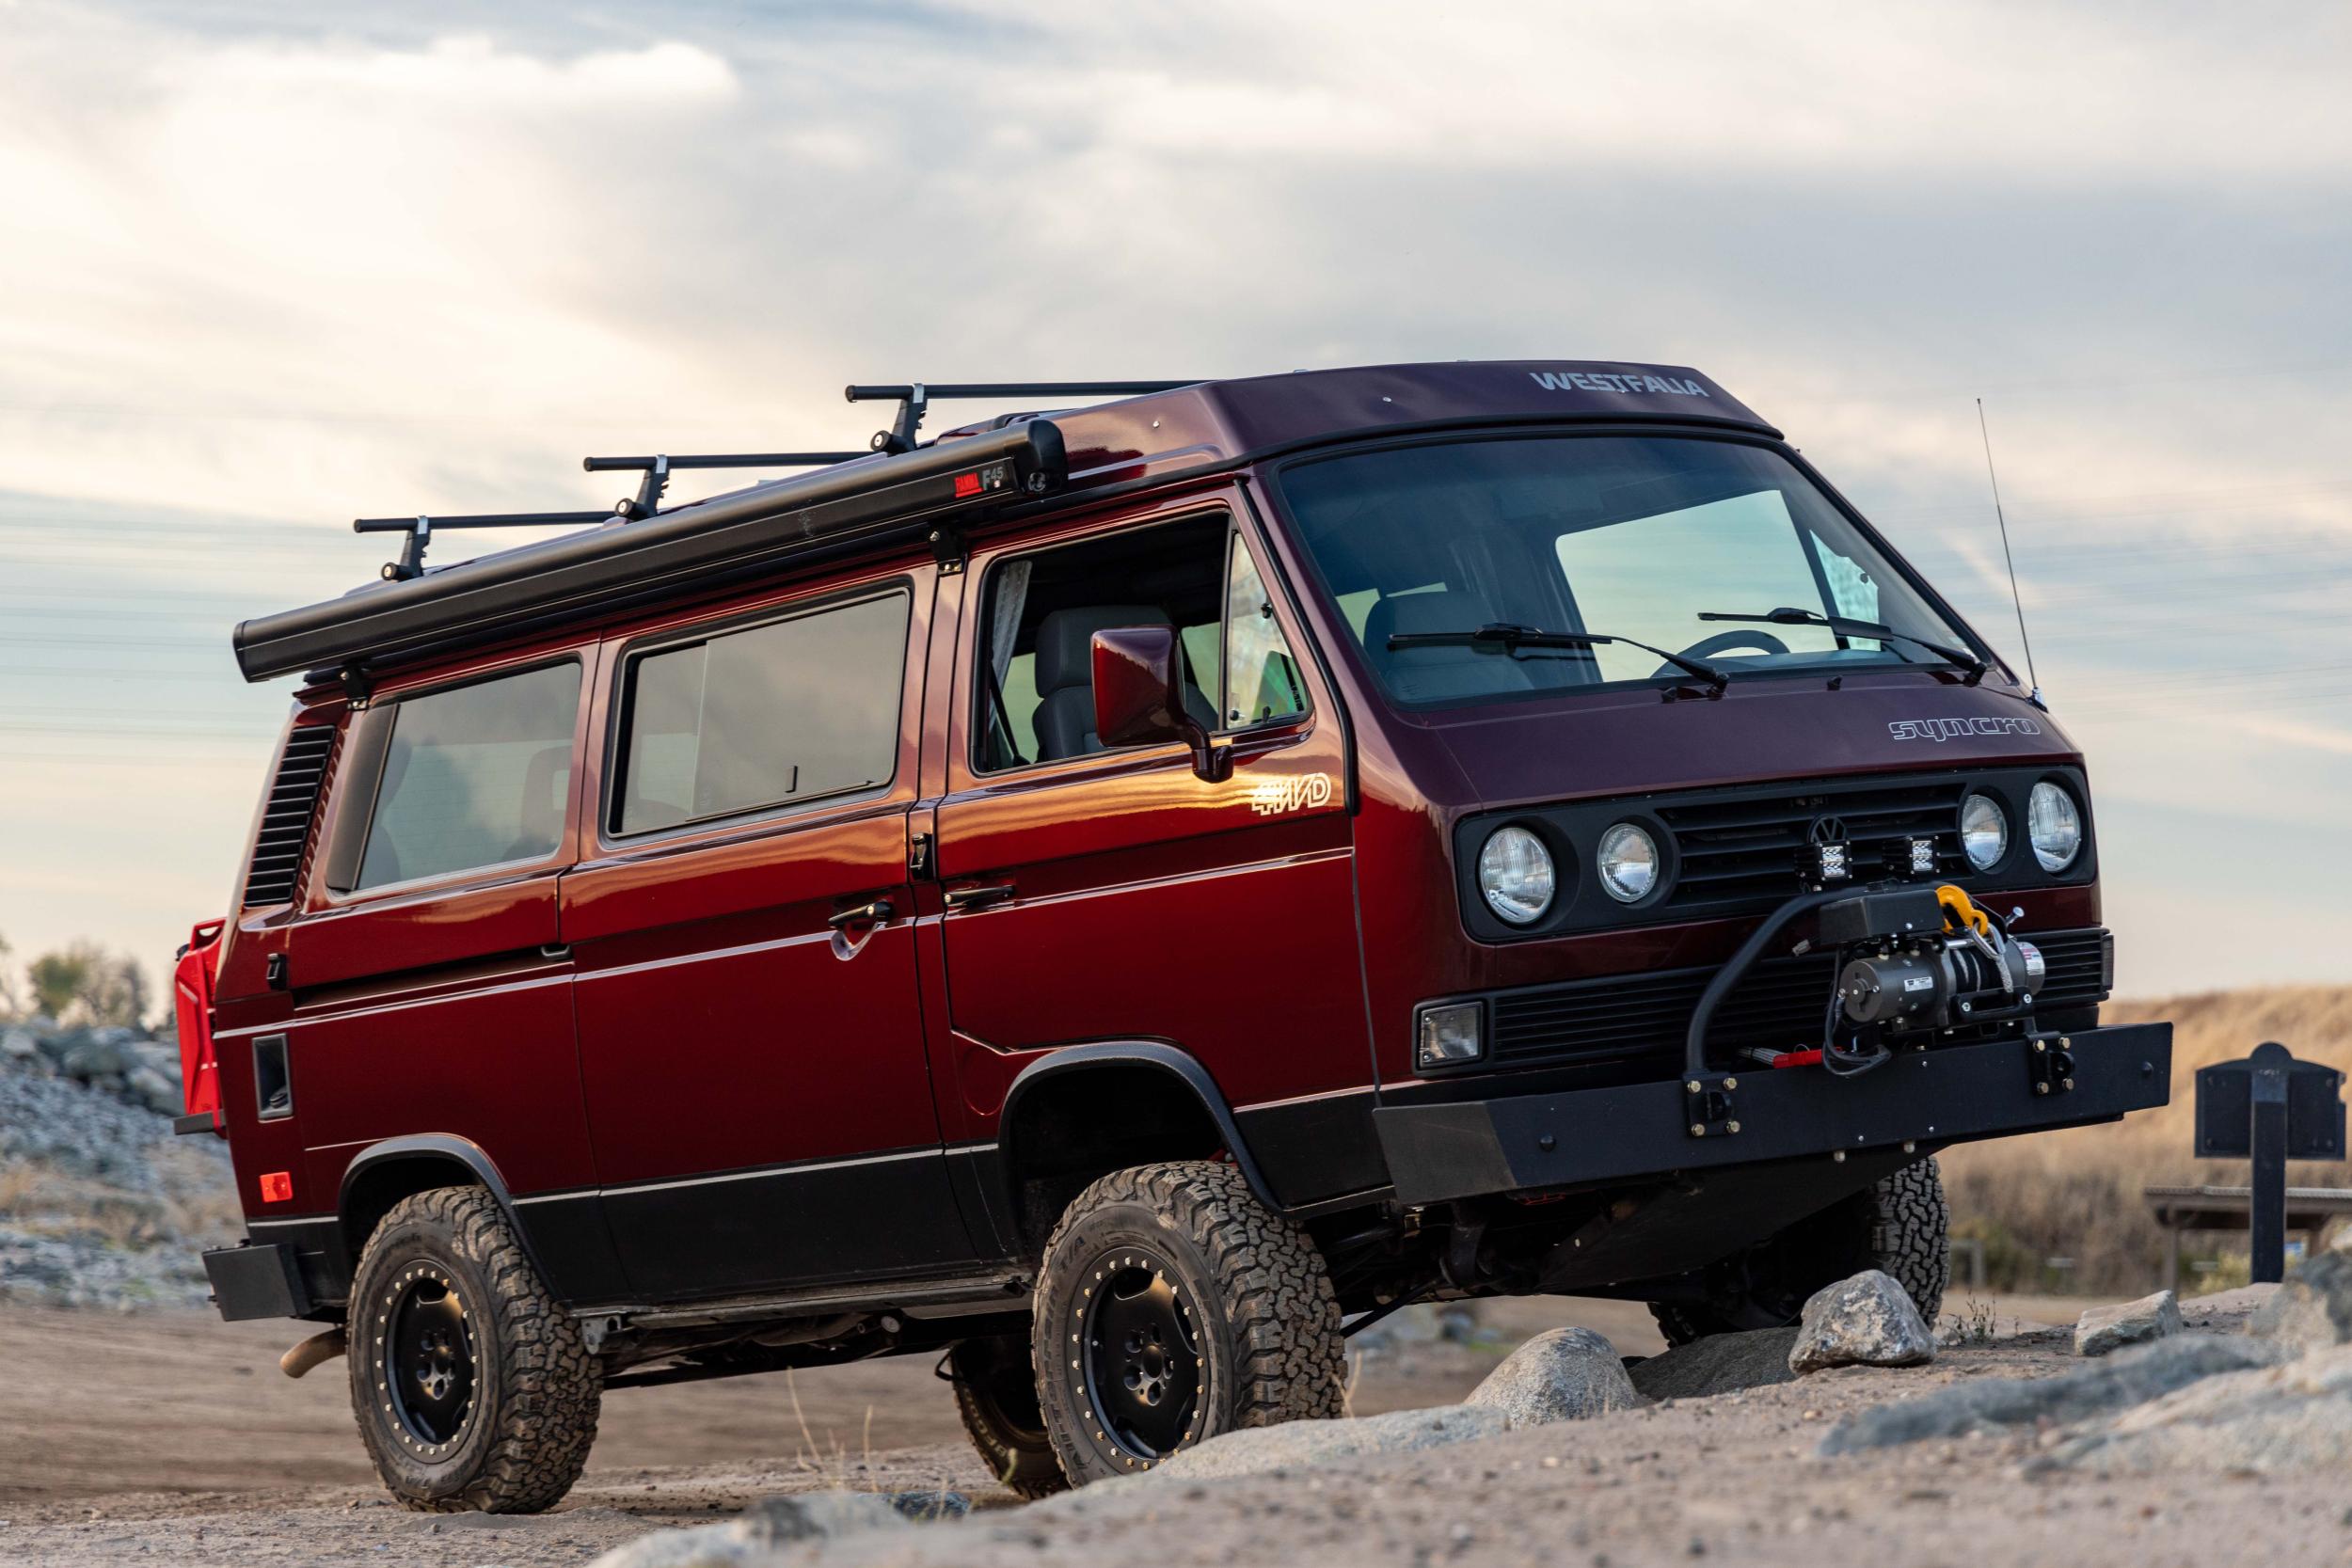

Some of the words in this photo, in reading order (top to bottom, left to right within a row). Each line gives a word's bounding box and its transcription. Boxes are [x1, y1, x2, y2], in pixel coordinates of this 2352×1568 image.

[1529, 372, 1710, 397] WESTFALIA
[1887, 717, 2041, 742] syncro
[1251, 772, 1331, 816] 4WD
